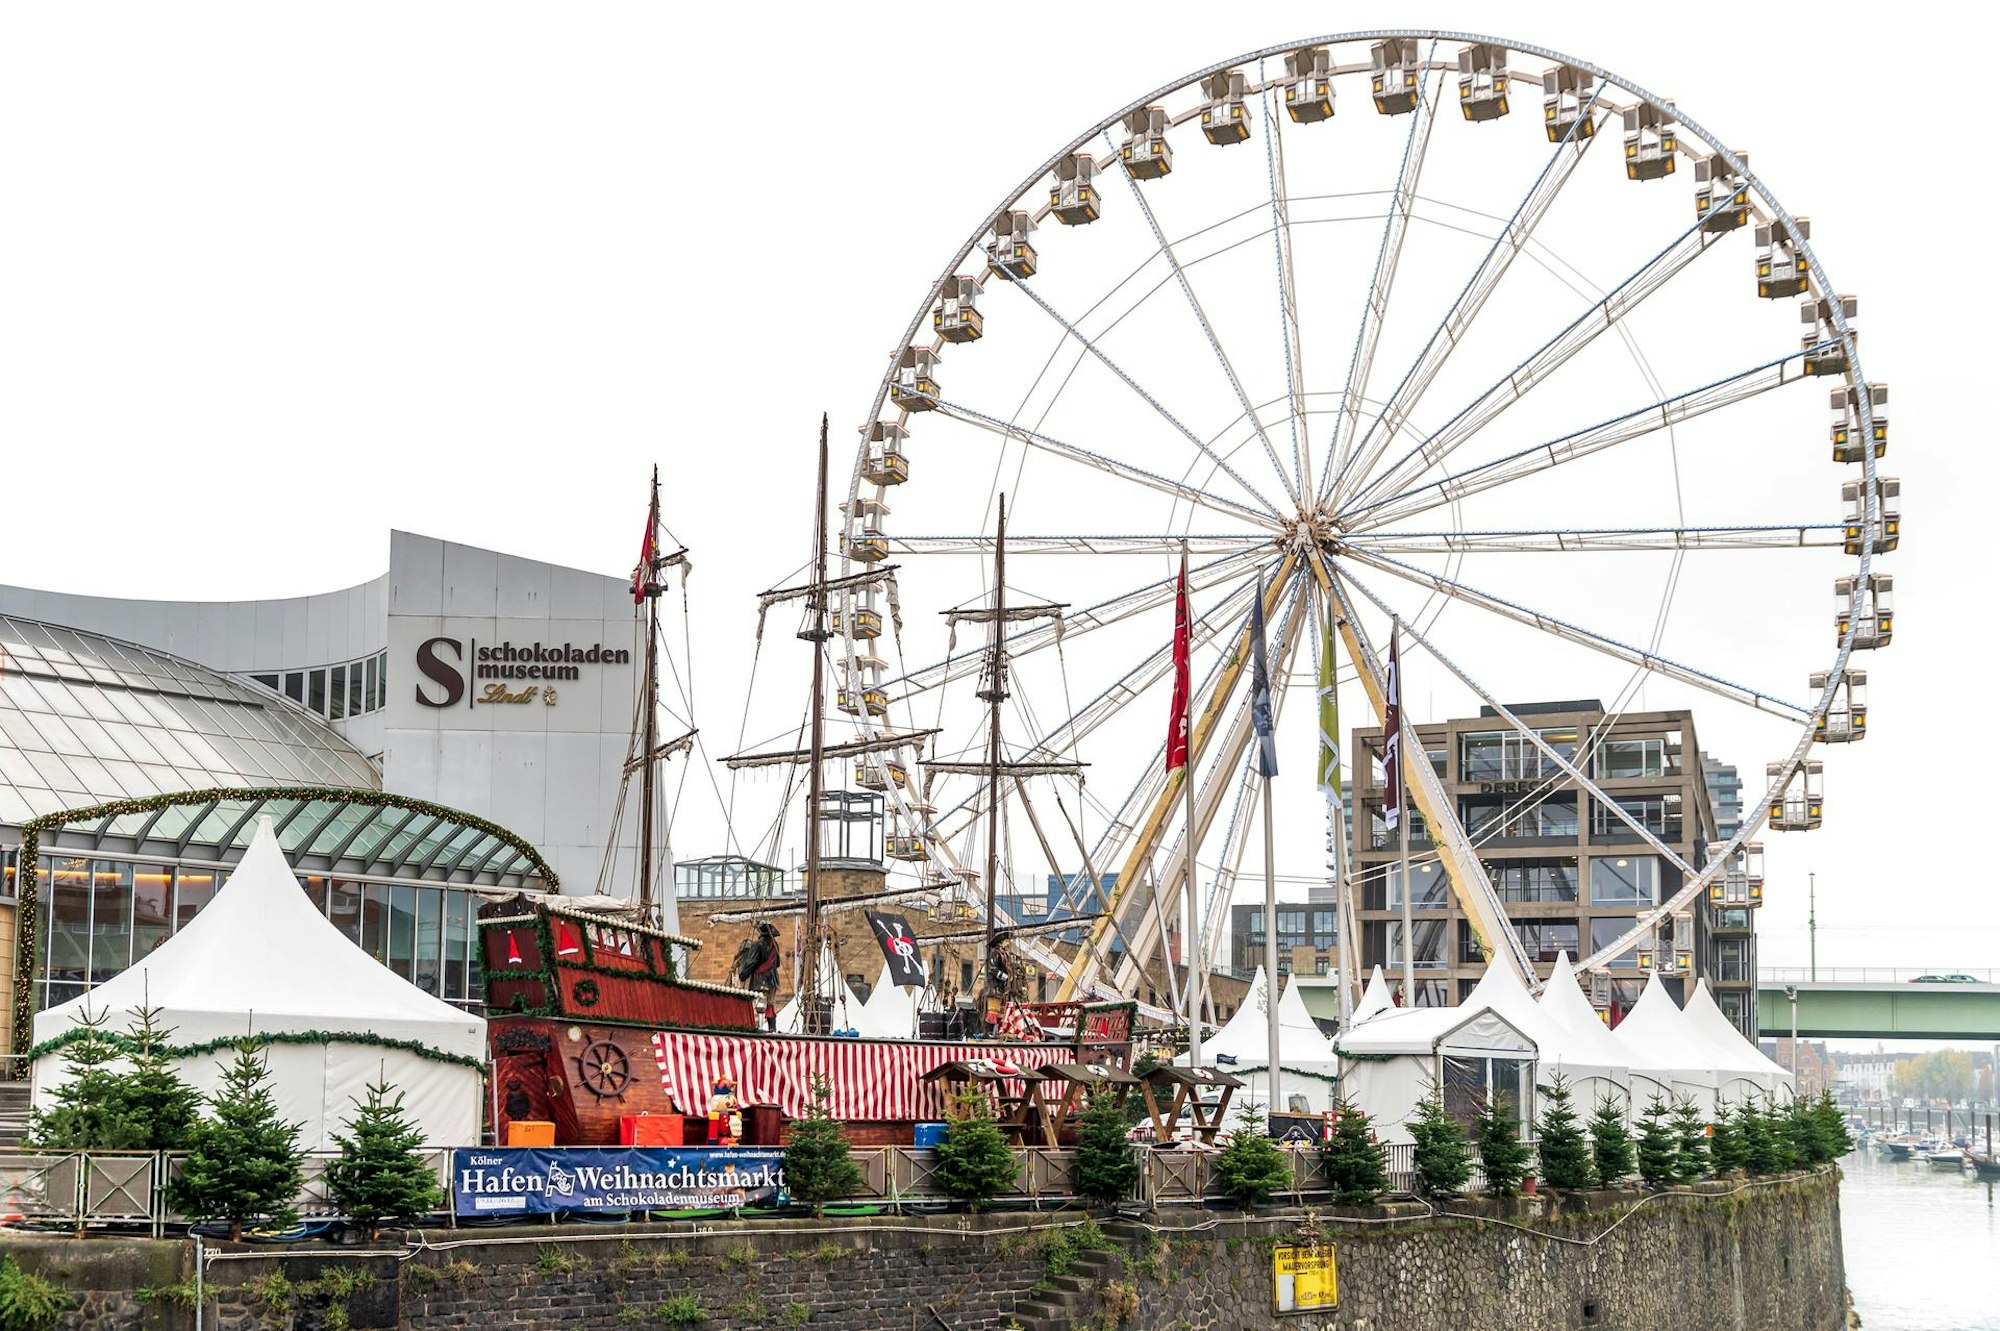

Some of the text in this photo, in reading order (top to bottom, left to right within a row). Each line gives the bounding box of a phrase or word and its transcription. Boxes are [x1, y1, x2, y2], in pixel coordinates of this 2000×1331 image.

[477, 642, 629, 664] schokoladen
[416, 637, 465, 708] S
[477, 664, 579, 680] museum
[477, 683, 539, 704] Lindt
[470, 1156, 503, 1166] Kölner
[461, 1164, 786, 1194] Hafen Weihnachtsmarkt
[583, 1191, 740, 1207] am Schokoladenmuseum
